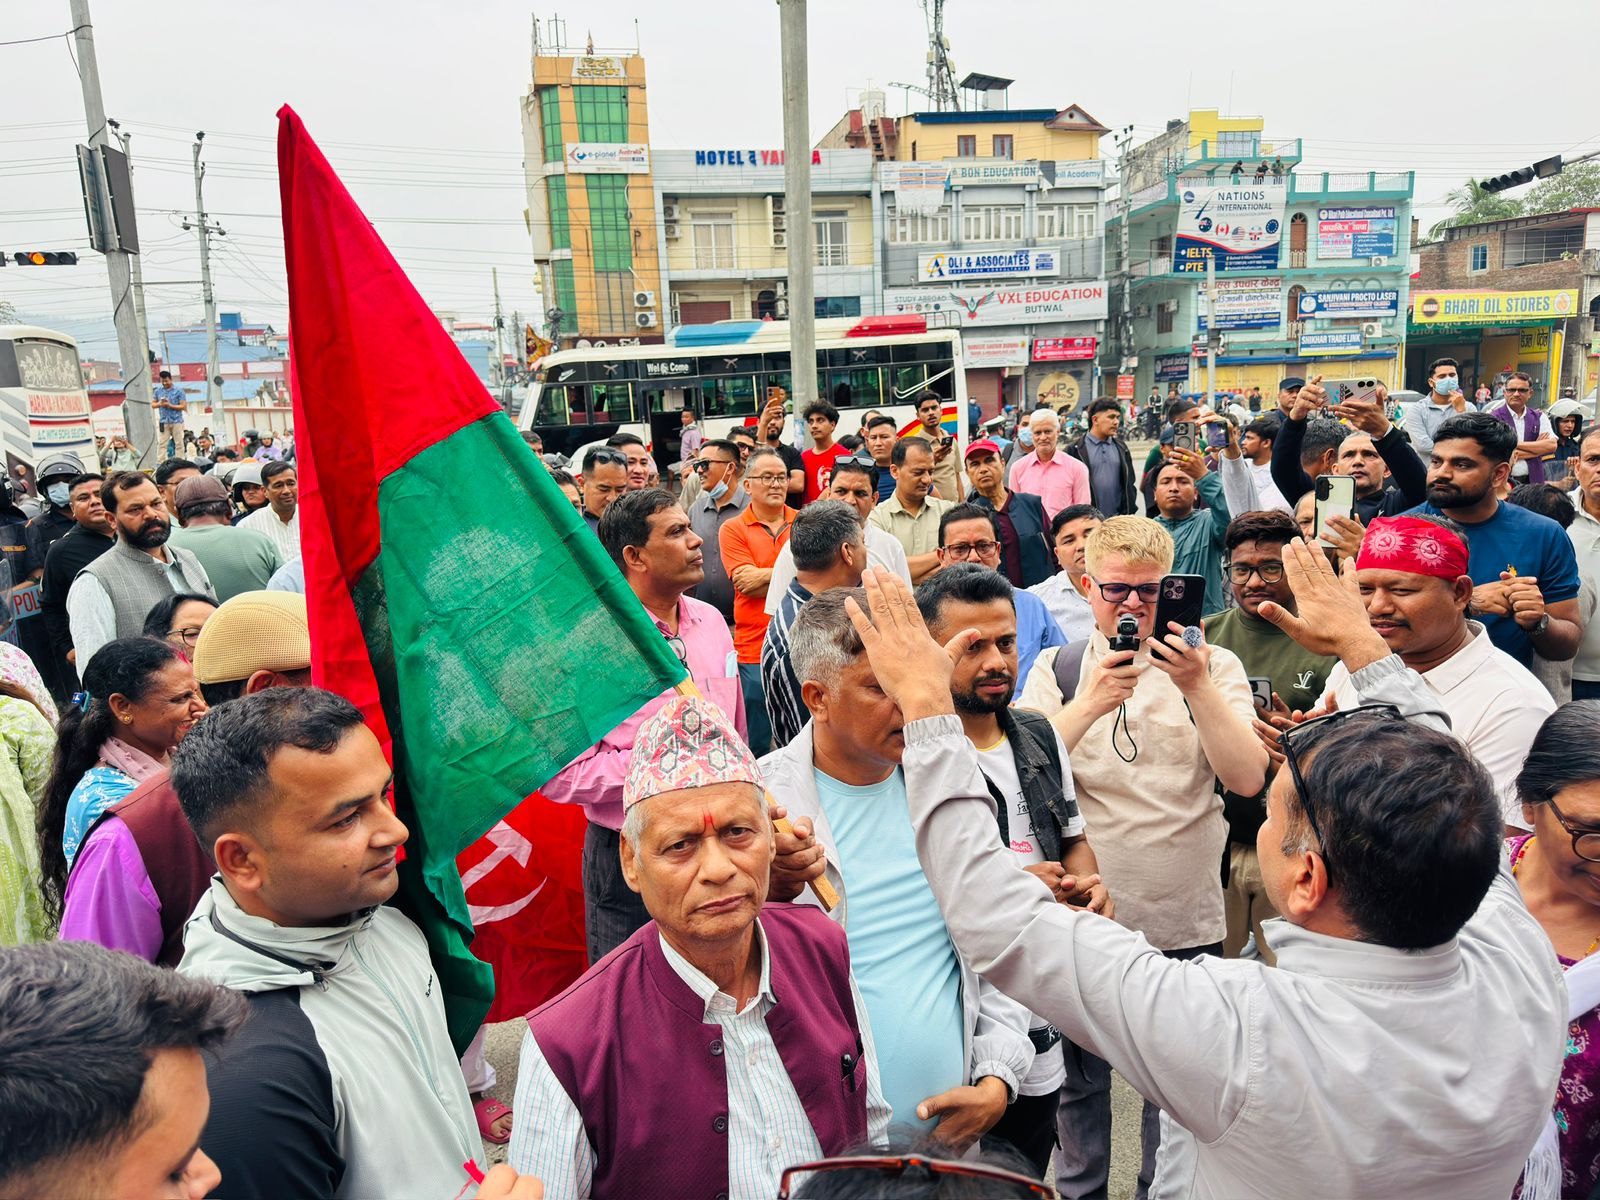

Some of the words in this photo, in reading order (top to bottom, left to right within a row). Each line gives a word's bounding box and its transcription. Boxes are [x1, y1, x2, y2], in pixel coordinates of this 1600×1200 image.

[695, 150, 744, 165] HOTEL
[760, 150, 821, 166] YAA
[961, 168, 980, 178] BON
[983, 166, 1036, 177] EDUCATION
[1067, 170, 1101, 180] Academy
[1217, 190, 1265, 201] NATIONS
[1216, 202, 1272, 212] INTERNATIONAL
[1186, 247, 1212, 258] IELTS
[948, 257, 963, 268] OLI
[965, 256, 972, 267] &
[975, 254, 1029, 268] ASSOCIATES
[1185, 262, 1204, 272] PTE
[997, 292, 1022, 305] VXL
[1026, 287, 1103, 304] EDUCATION
[1317, 292, 1350, 303] SANJIVANI
[1351, 292, 1375, 301] PROCTO
[1376, 291, 1397, 301] LASER
[1025, 304, 1063, 314] BUTWAL
[1444, 298, 1479, 314] BHARI
[1484, 298, 1502, 314] OIL
[1506, 296, 1550, 312] STORES
[1301, 335, 1328, 345] SHIKHAR
[1328, 334, 1346, 343] TRADE
[1347, 333, 1360, 342] LINK
[646, 363, 660, 373] Wel
[669, 362, 689, 372] Come
